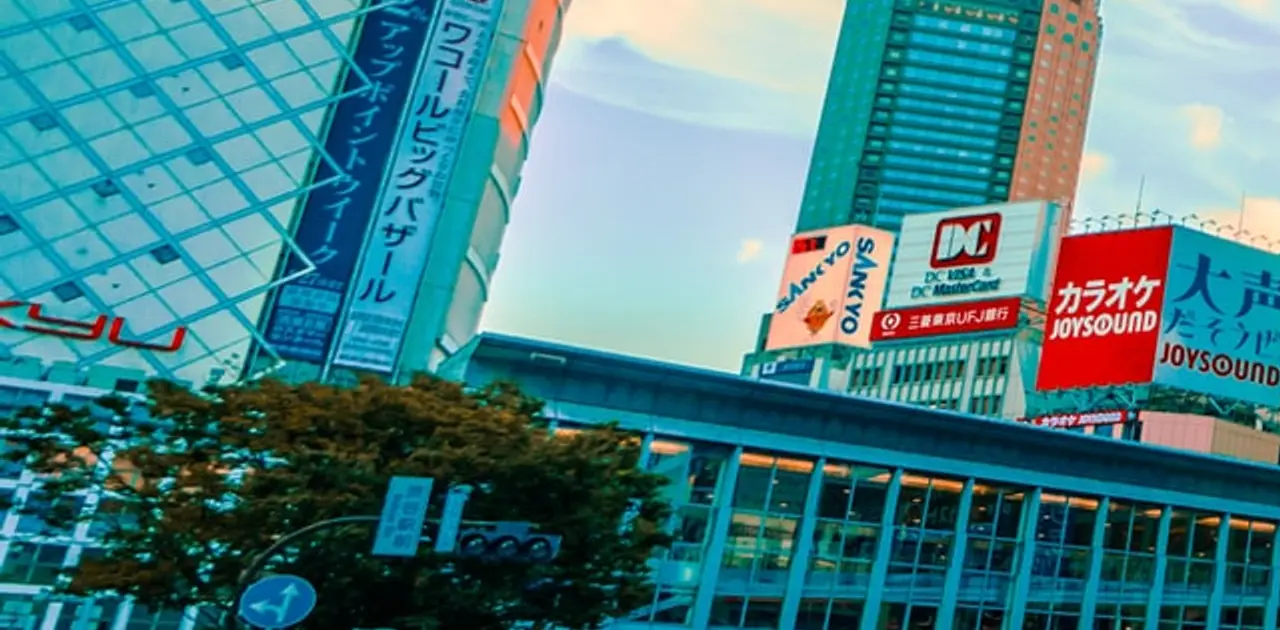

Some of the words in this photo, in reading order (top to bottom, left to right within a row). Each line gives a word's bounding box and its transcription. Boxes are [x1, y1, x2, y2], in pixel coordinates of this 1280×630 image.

[360, 21, 472, 302] ワコールビッグバザール
[776, 241, 850, 314] SANKYO
[841, 237, 878, 335] SANKYO
[1055, 275, 1161, 315] カラオケ
[1050, 311, 1158, 340] JOYSOUND
[1160, 342, 1280, 387] JOYSOUND
